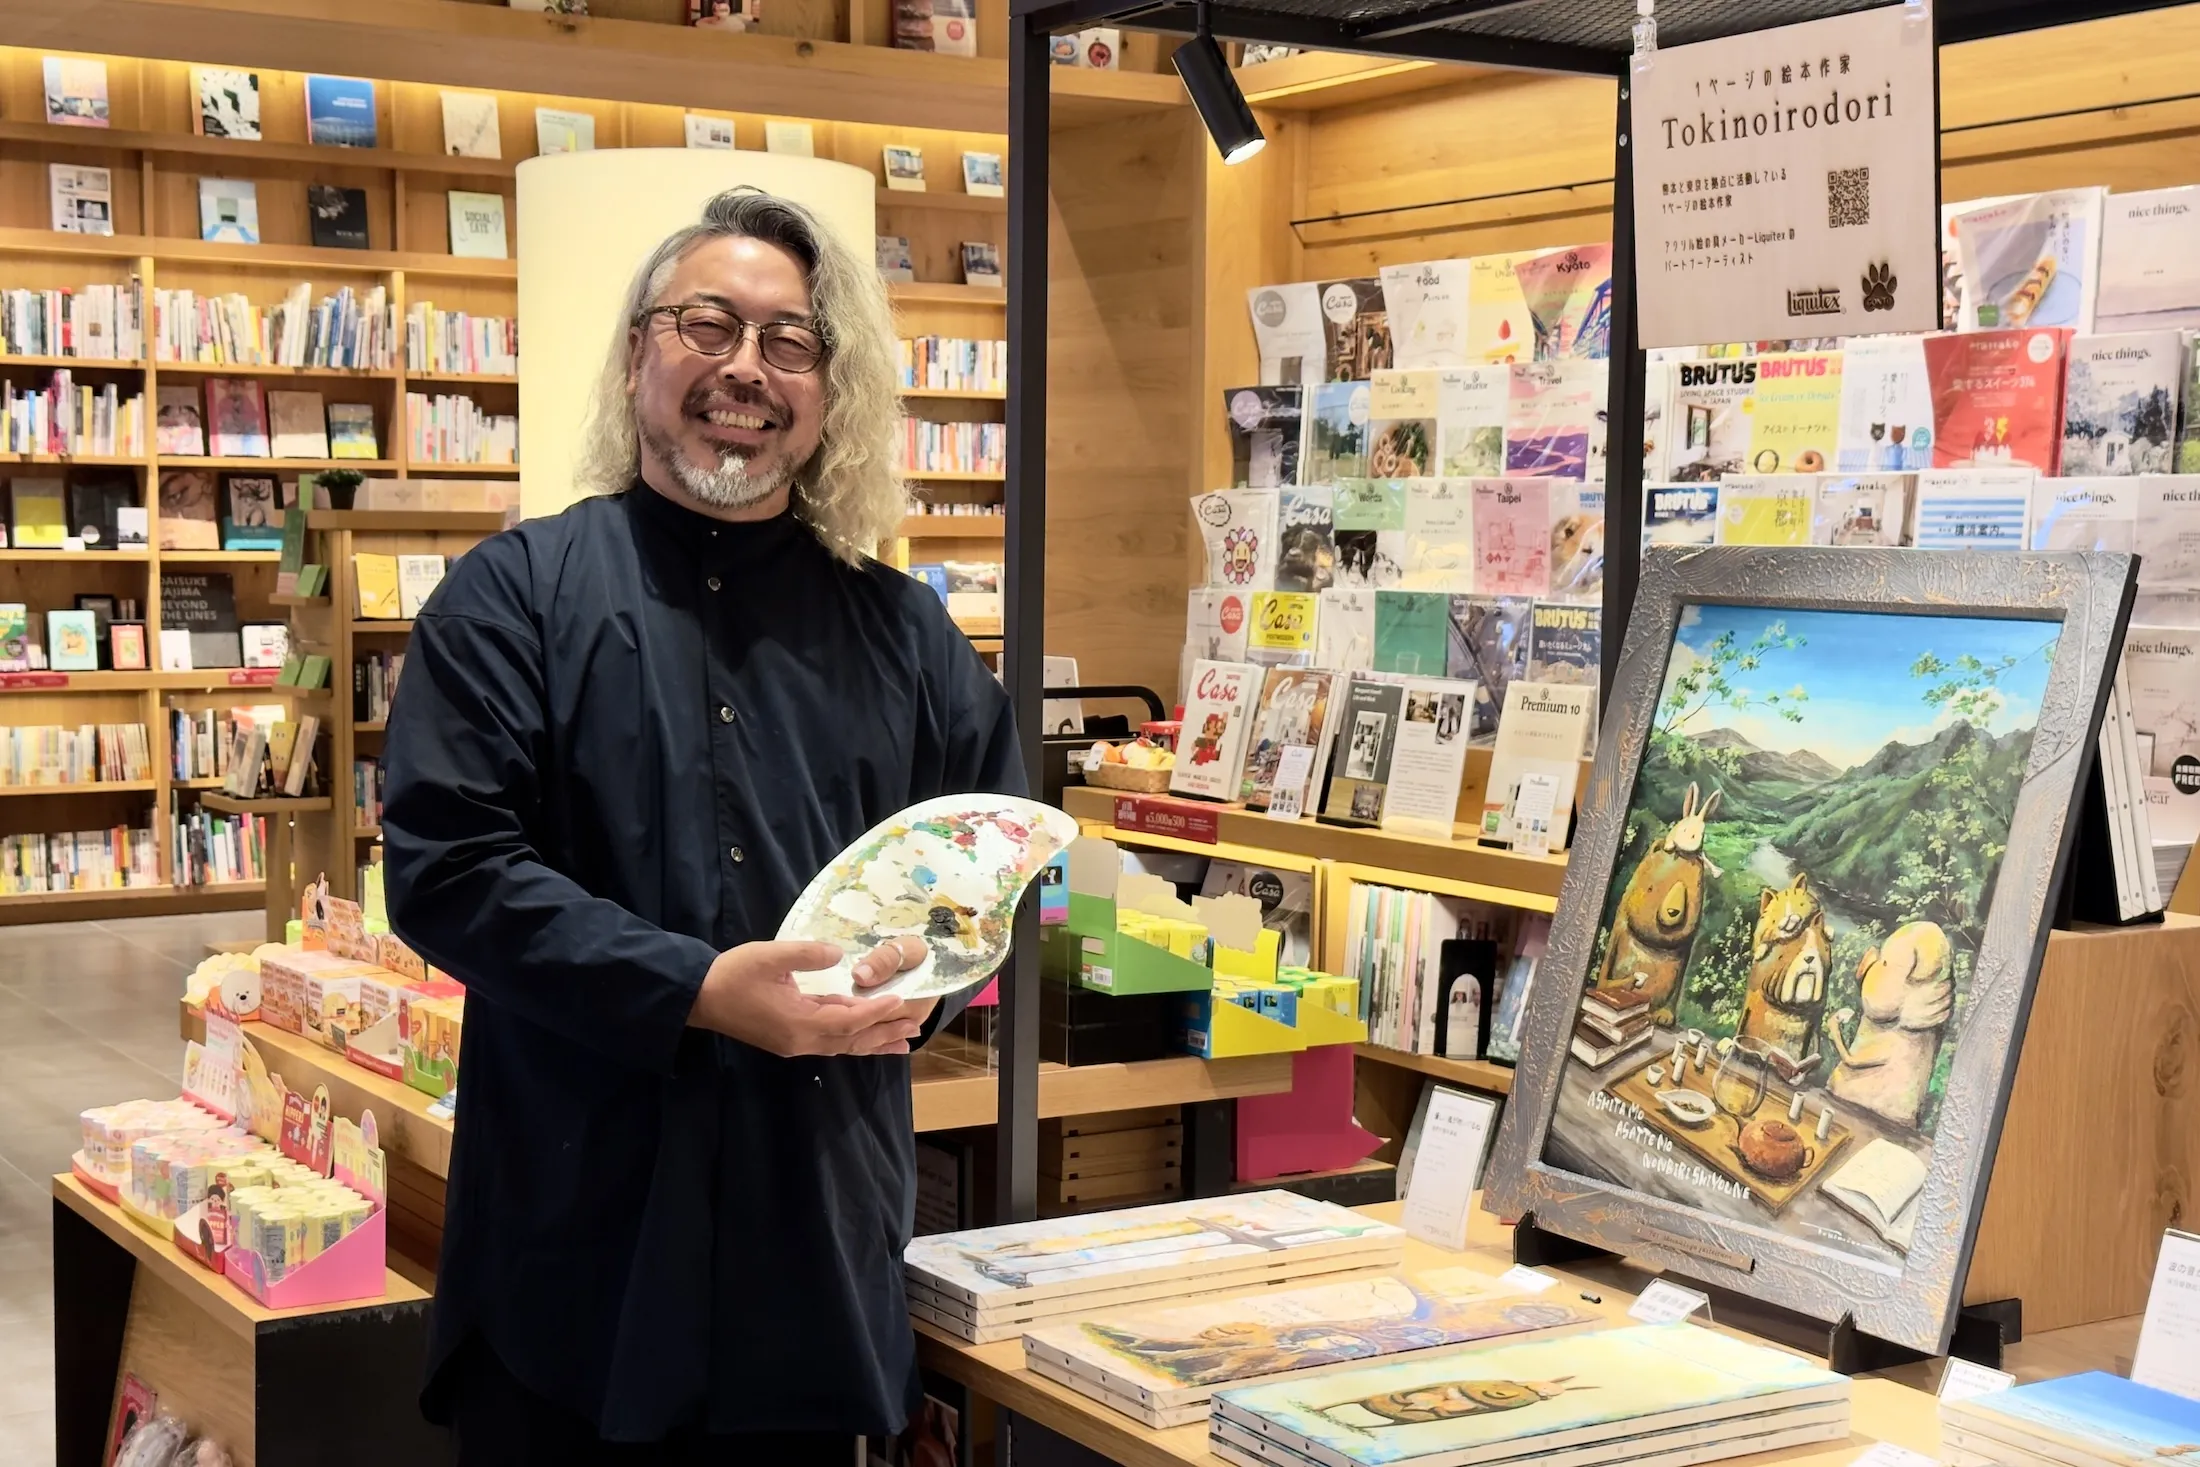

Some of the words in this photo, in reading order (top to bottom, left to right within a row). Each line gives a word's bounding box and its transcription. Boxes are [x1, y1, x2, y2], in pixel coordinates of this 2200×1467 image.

[1695, 54, 1850, 97] 1ページの絵本作家
[1662, 81, 1893, 149] Tokinoirodori
[2128, 205, 2151, 219] nice
[1556, 260, 1591, 273] Kyoto
[1326, 295, 1353, 310] Casa
[1787, 287, 1841, 317] Liquitex
[2091, 349, 2112, 361] nice
[2114, 347, 2152, 361] things.
[1680, 361, 1757, 387] BRUTUS
[1760, 356, 1828, 380] BRUTUS
[1538, 375, 1562, 386] Travel
[1496, 492, 1522, 504] Taipei
[1654, 489, 1712, 512] BRUTUS
[2162, 490, 2187, 502] nice
[1285, 495, 1332, 527] Casa
[160, 587, 201, 598] AJIMA
[185, 610, 217, 620] LINES
[1220, 607, 1242, 621] Casa
[1259, 599, 1303, 630] Casa
[1534, 607, 1587, 630] BRUTUS
[2128, 641, 2151, 653] nice
[2154, 640, 2194, 658] things.
[1196, 667, 1240, 702] Casa
[1270, 676, 1316, 711] Casa
[1520, 695, 1568, 715] Premium
[1570, 705, 1581, 716] 10
[1252, 880, 1281, 897] Casa
[1587, 1090, 1627, 1115] ASHITA
[1615, 1121, 1655, 1147] ASATTE
[1691, 1169, 1751, 1200] SHIYOUNE
